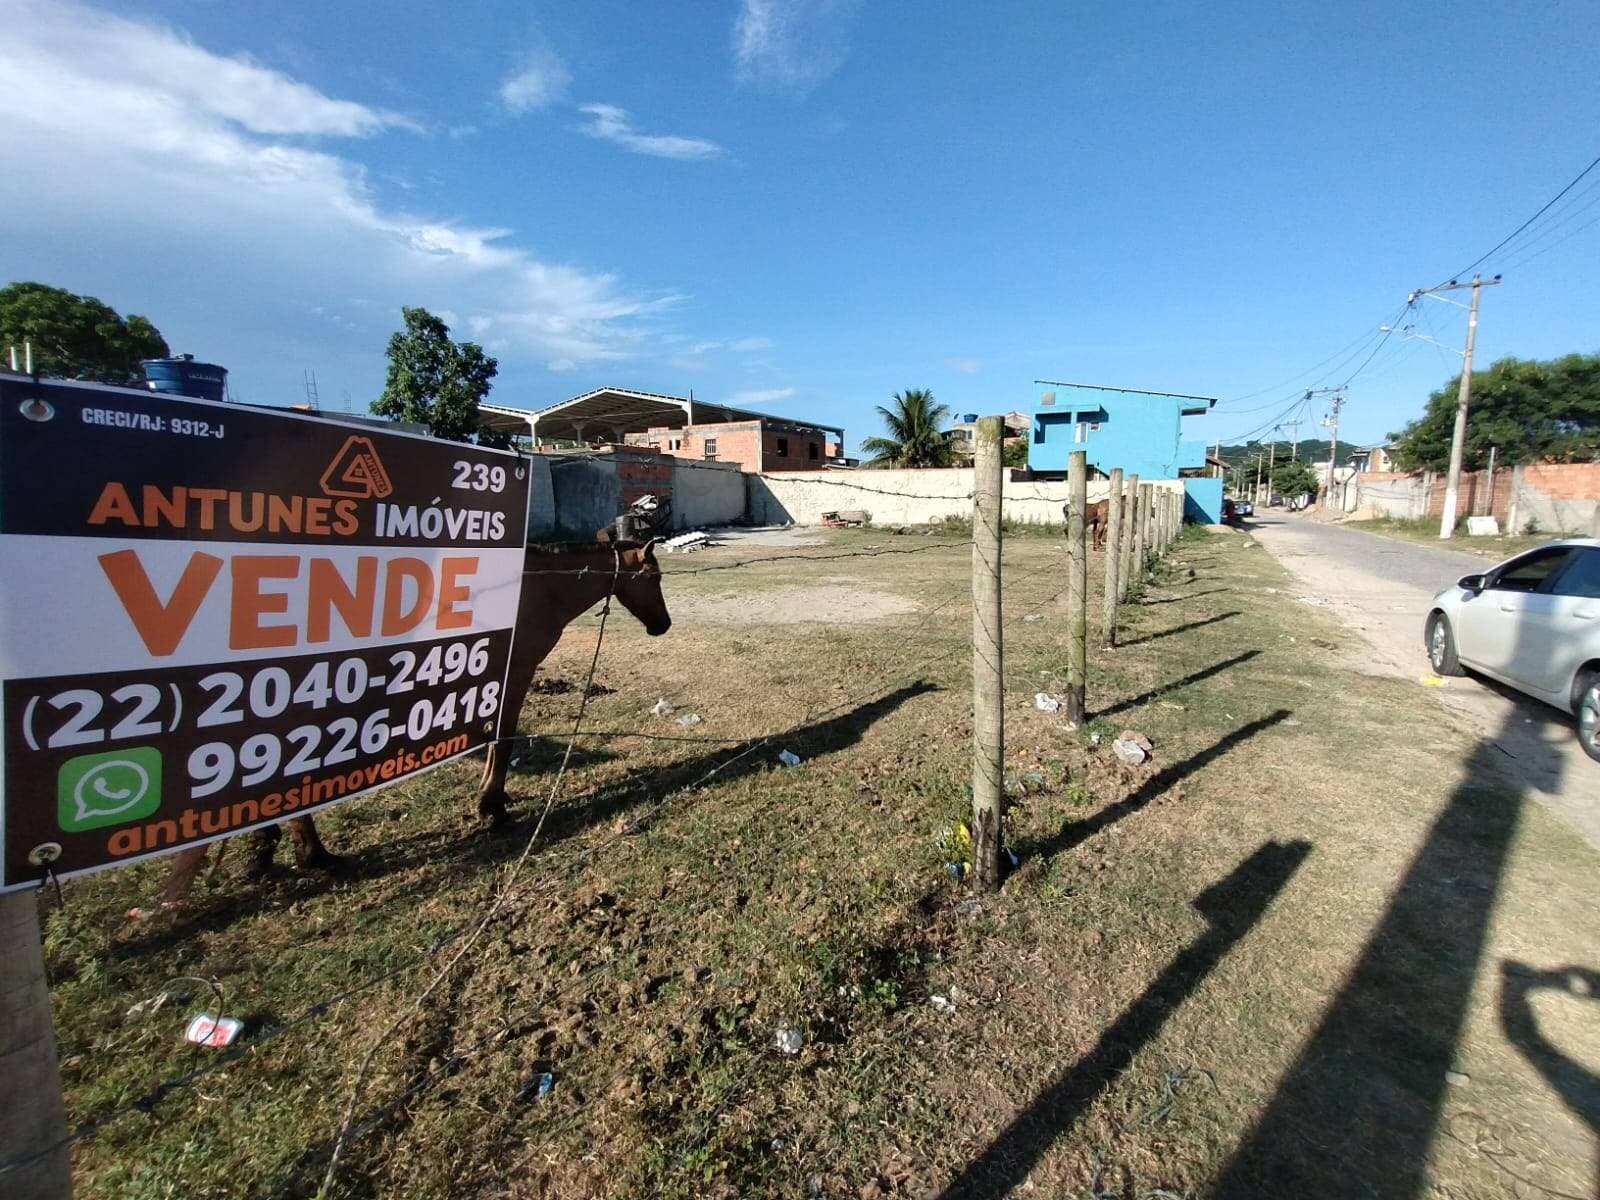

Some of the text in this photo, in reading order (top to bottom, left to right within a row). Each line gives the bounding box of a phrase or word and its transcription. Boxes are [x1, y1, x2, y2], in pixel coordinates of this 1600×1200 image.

[81, 407, 225, 439] CRECI/RJ: 9312-J
[451, 461, 506, 493] 239
[87, 482, 506, 541] ANTUNES IMÓVEIS
[97, 549, 480, 657] VENDE
[23, 638, 490, 750] (22) 2040-2496
[187, 681, 500, 799] 99226-0418
[107, 732, 469, 856] antunesimoveis.com
